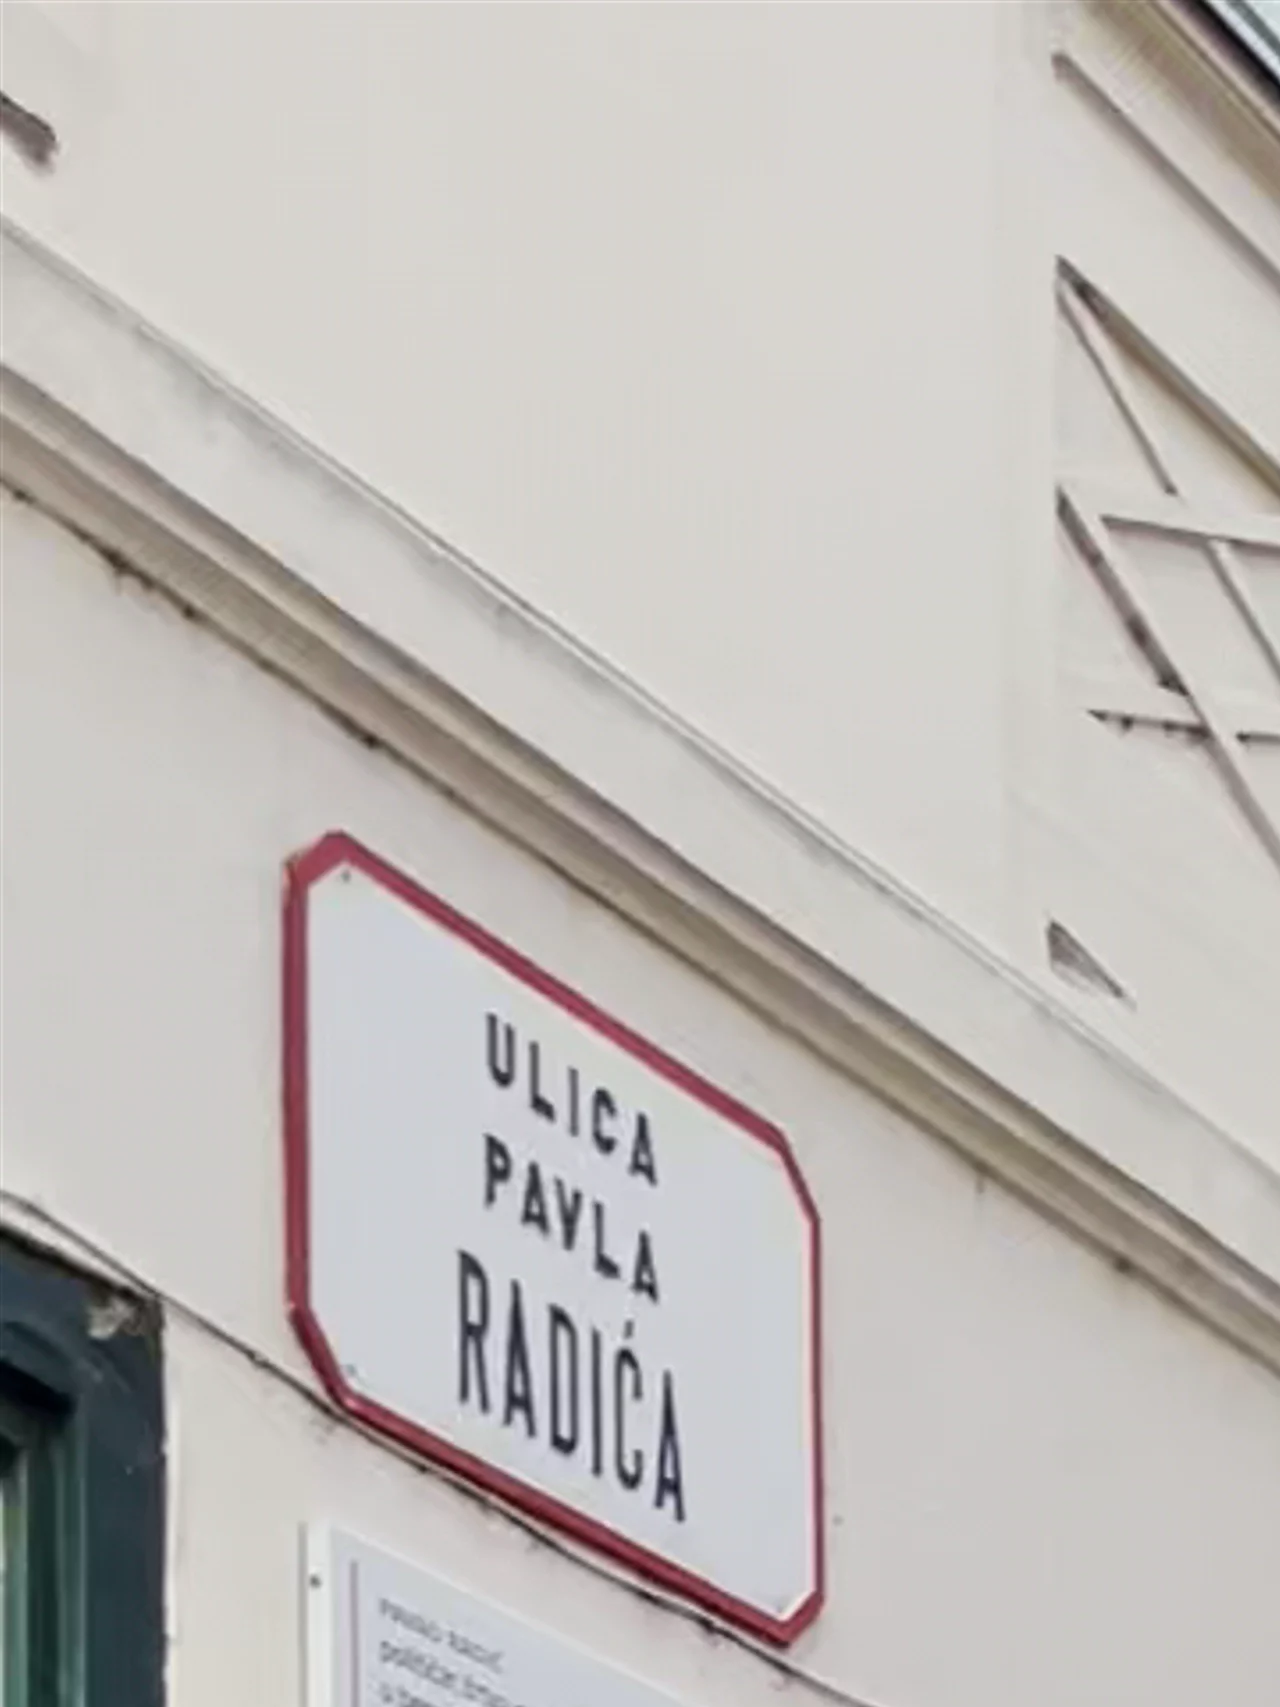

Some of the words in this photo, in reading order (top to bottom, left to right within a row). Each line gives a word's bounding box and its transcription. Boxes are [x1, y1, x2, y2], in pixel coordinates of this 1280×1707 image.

[484, 1011, 660, 1188] ULICA
[481, 1132, 660, 1305] PAVLA
[456, 1247, 687, 1524] RADIĆA
